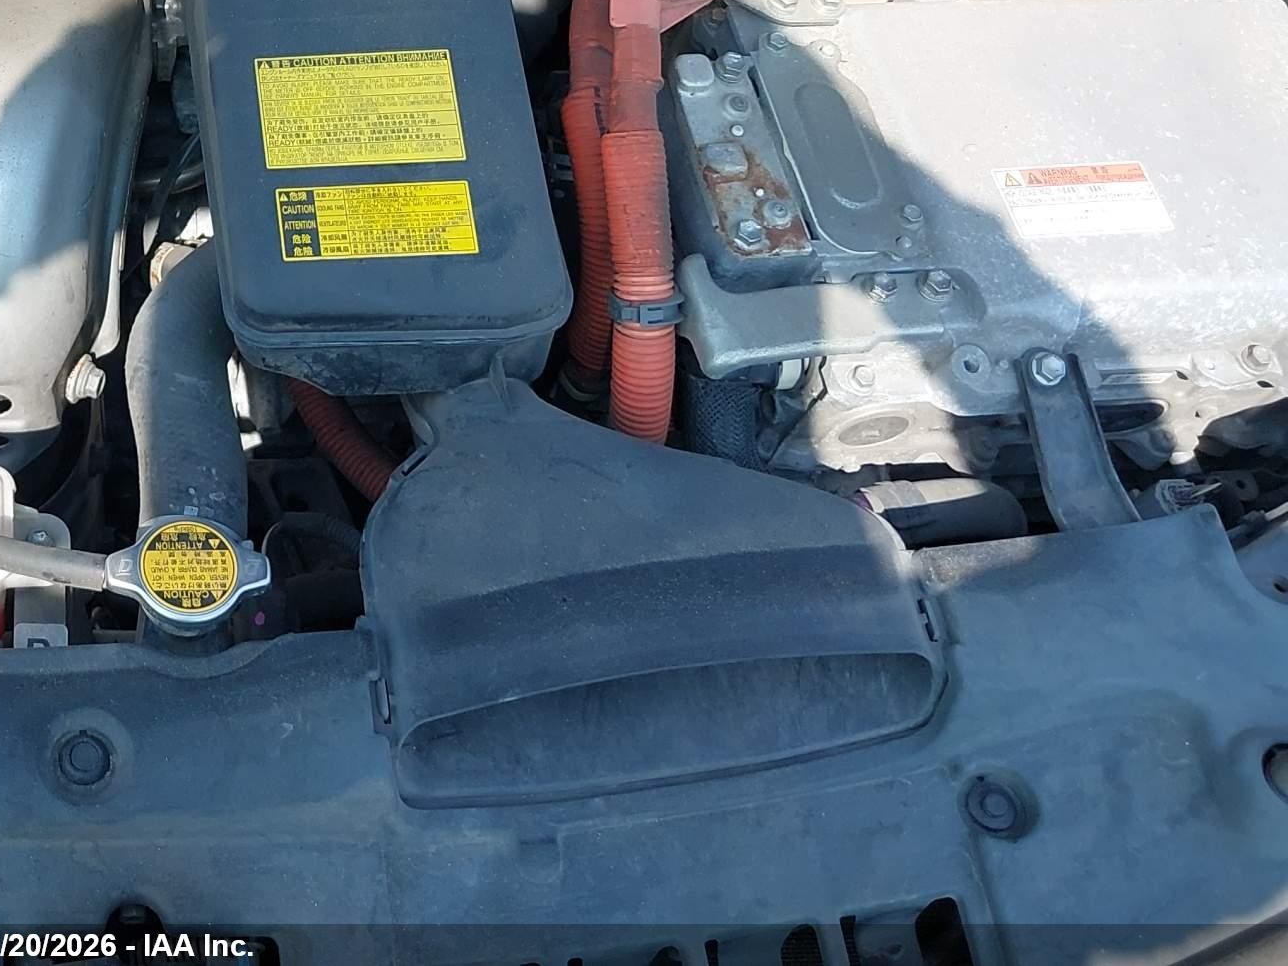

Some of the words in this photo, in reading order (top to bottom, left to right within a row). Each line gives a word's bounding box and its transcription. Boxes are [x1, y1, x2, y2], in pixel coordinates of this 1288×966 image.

[293, 57, 337, 67] CAUTION
[340, 55, 394, 65] ATTENTION
[396, 52, 446, 62] ВНИМАНИЕ
[282, 204, 314, 215] CAUTION
[284, 220, 316, 230] ATTENTION
[164, 590, 209, 598] CAUTION
